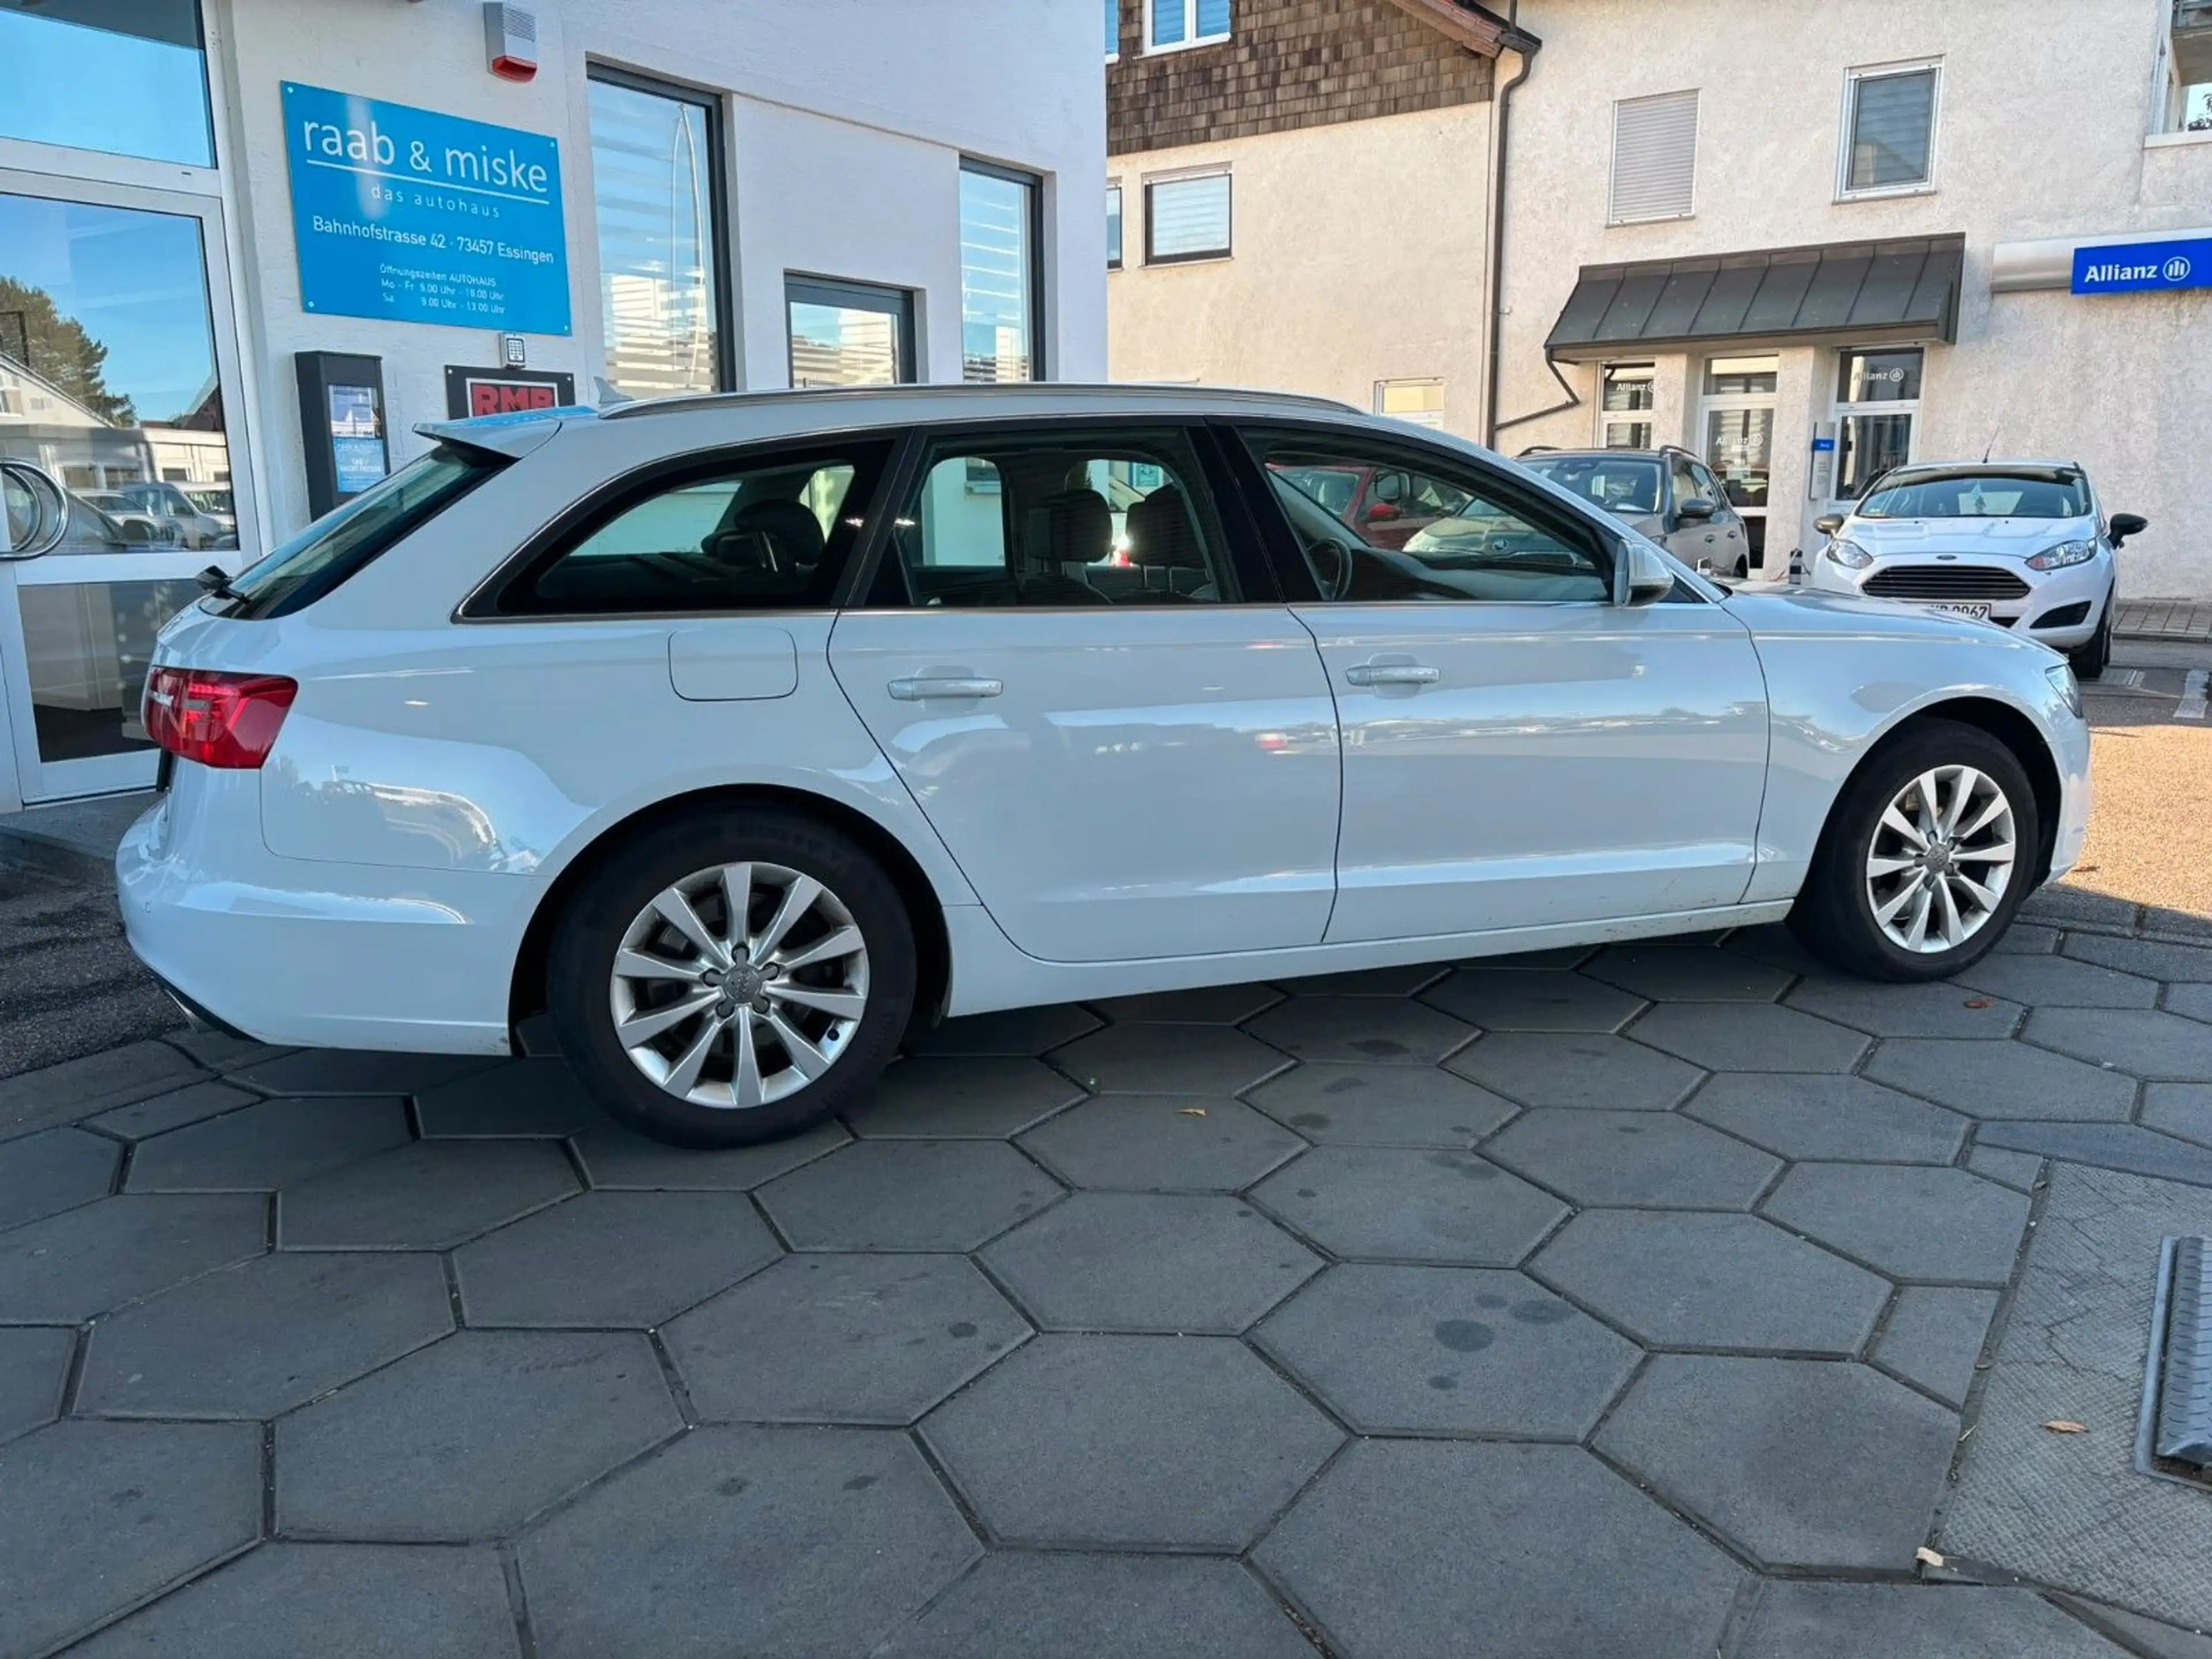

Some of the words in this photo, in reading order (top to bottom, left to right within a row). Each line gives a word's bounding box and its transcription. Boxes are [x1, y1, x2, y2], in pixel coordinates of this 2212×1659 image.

[304, 120, 395, 165] raab
[410, 141, 432, 173] &
[445, 145, 547, 192] miske
[372, 185, 403, 202] das
[414, 195, 499, 218] autohaus
[313, 215, 426, 246] Bahnhofstrasse
[430, 233, 446, 249] 42
[456, 236, 494, 255] 73457
[498, 241, 554, 265] Essingen
[449, 274, 497, 287] AUTOHAUS
[2084, 264, 2158, 283] Allianz
[381, 278, 395, 289] Mo
[440, 284, 457, 296] Uhr
[441, 298, 457, 309] Uhr
[491, 304, 506, 314] Uhr
